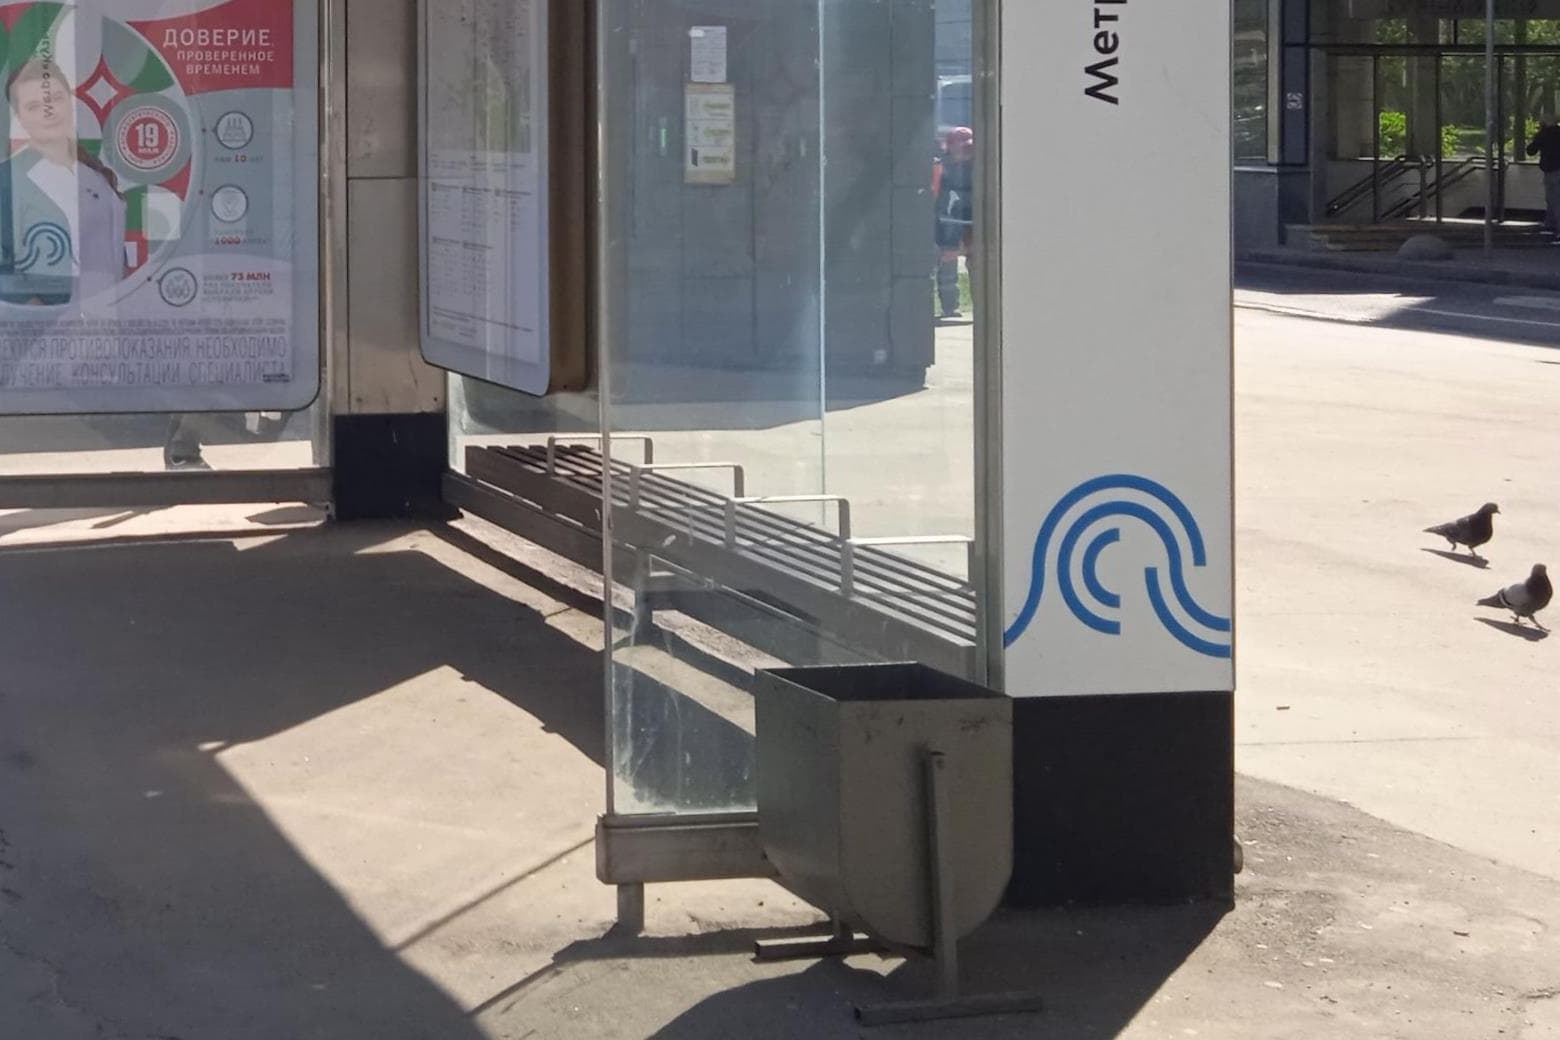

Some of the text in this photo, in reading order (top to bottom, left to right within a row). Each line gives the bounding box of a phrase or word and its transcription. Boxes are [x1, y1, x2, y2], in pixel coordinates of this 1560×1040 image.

[176, 50, 274, 62] ПРОВЕРЕННОЕ
[186, 64, 260, 75] ВРЕМЕНЕМ
[135, 123, 159, 147] 19
[196, 336, 287, 358] НЕОБХОДИМО
